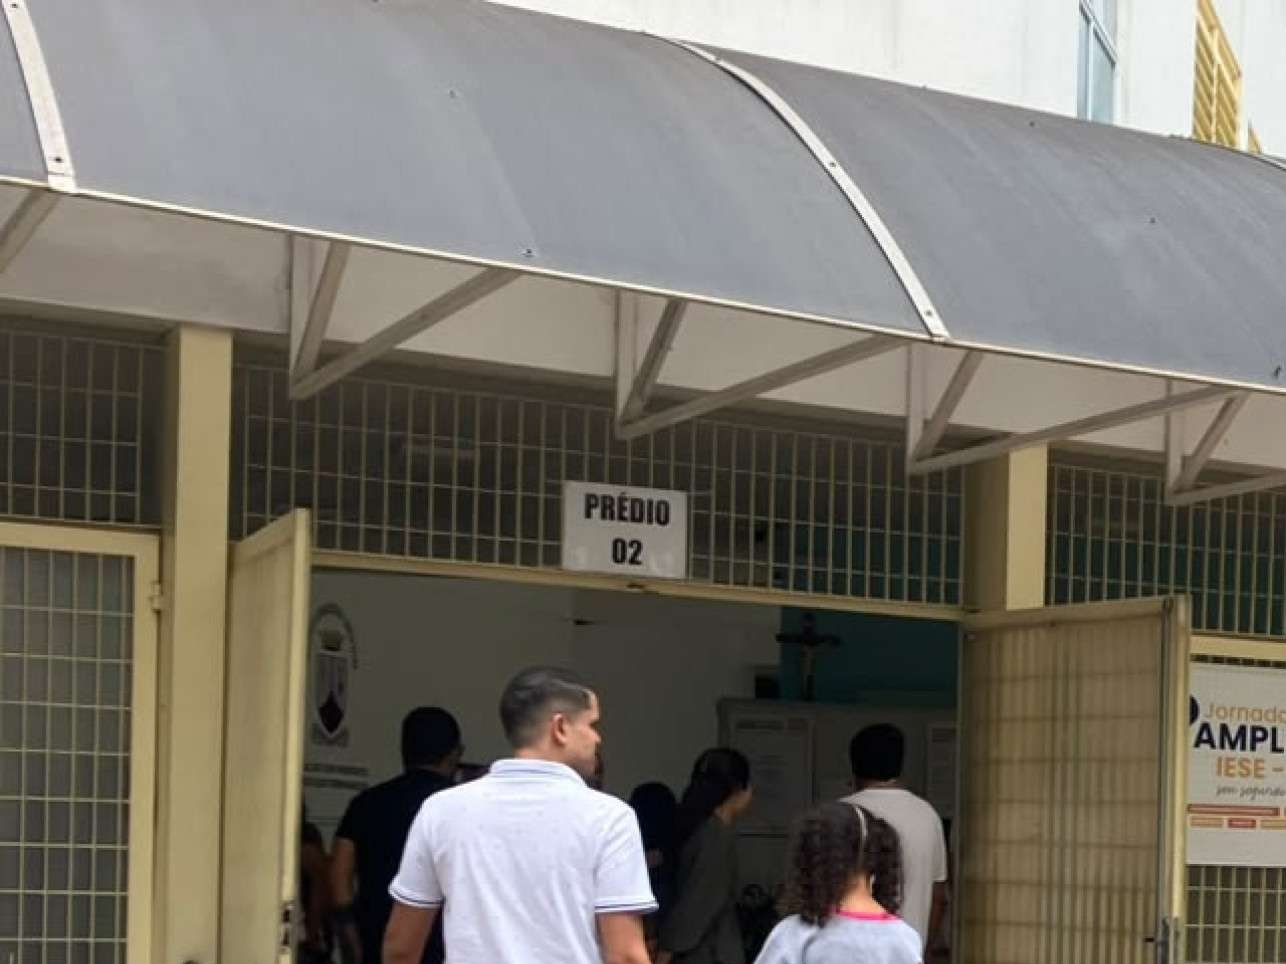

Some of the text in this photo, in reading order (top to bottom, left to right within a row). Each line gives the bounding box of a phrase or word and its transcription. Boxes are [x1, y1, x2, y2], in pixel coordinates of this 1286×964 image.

[584, 491, 670, 526] PRÉDIO
[612, 537, 643, 566] 02
[1216, 756, 1267, 779] IESE
